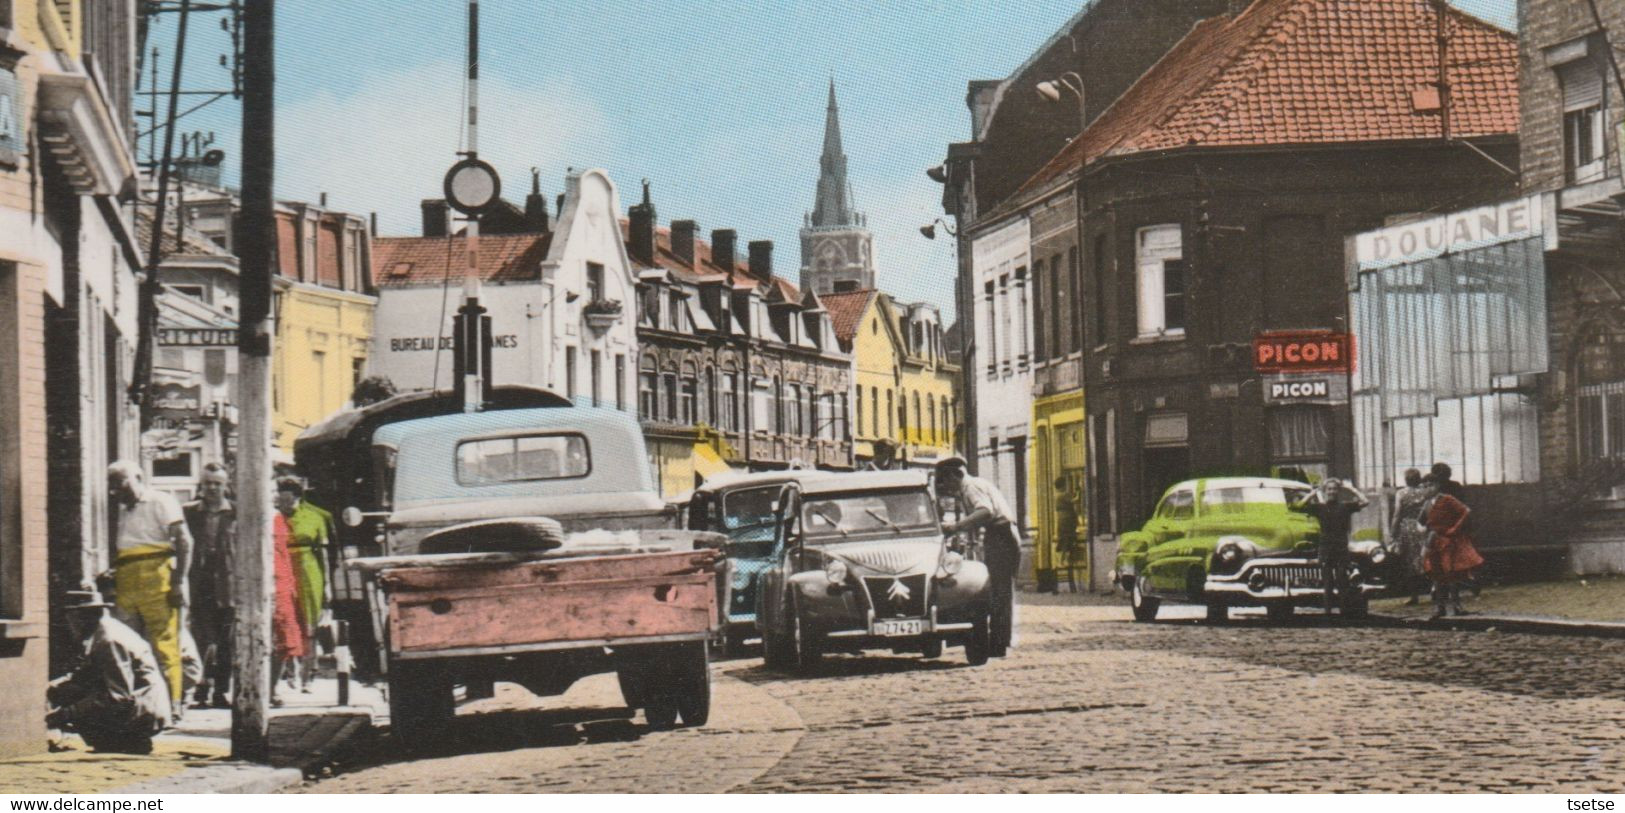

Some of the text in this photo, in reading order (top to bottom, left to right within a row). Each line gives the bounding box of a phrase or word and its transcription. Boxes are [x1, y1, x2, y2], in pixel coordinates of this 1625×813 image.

[1373, 204, 1527, 260] DOUANE
[391, 337, 434, 351] BUREAU
[1259, 342, 1338, 363] PICON
[1272, 382, 1326, 397] PICON
